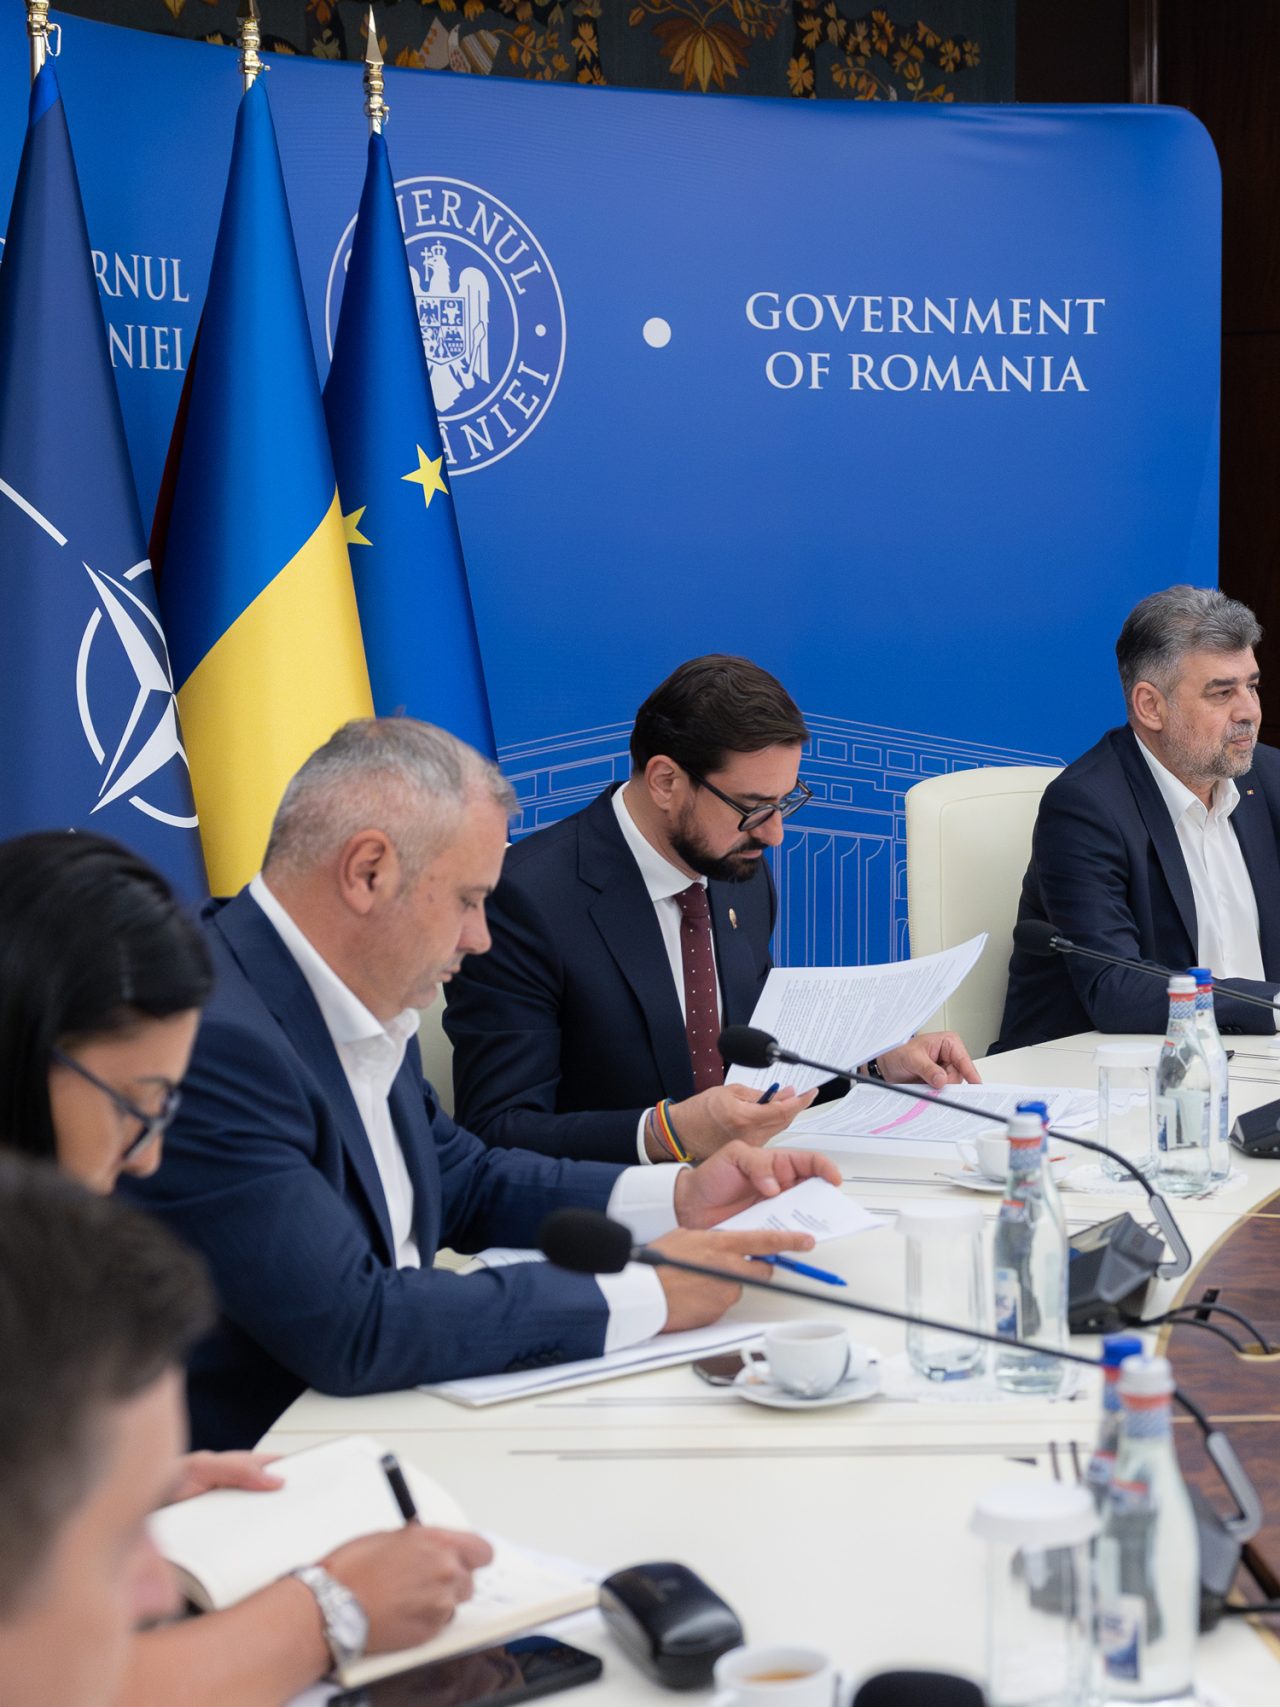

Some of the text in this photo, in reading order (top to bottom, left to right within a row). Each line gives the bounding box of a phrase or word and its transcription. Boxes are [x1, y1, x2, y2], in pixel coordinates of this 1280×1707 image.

[91, 249, 190, 303] RNUL
[745, 291, 1106, 335] GOVERNMENT
[108, 322, 185, 371] NIEI
[765, 351, 1090, 392] OF ROMANIA
